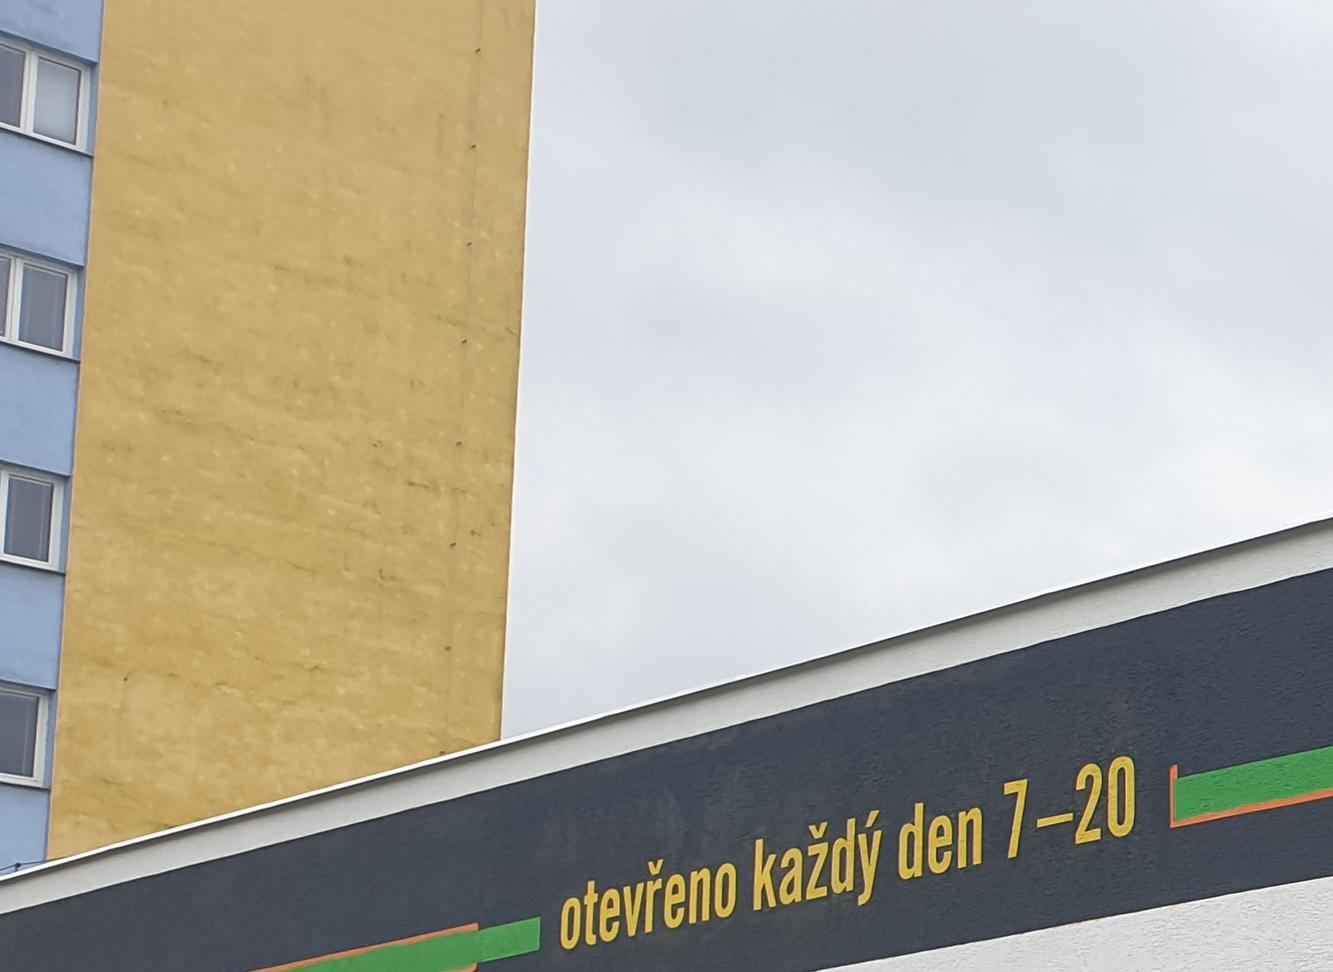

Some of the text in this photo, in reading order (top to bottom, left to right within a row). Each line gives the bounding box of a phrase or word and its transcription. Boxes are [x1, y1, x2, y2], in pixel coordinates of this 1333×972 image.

[559, 858, 737, 950] otevřeno
[753, 810, 882, 912] každý
[898, 802, 983, 880] den
